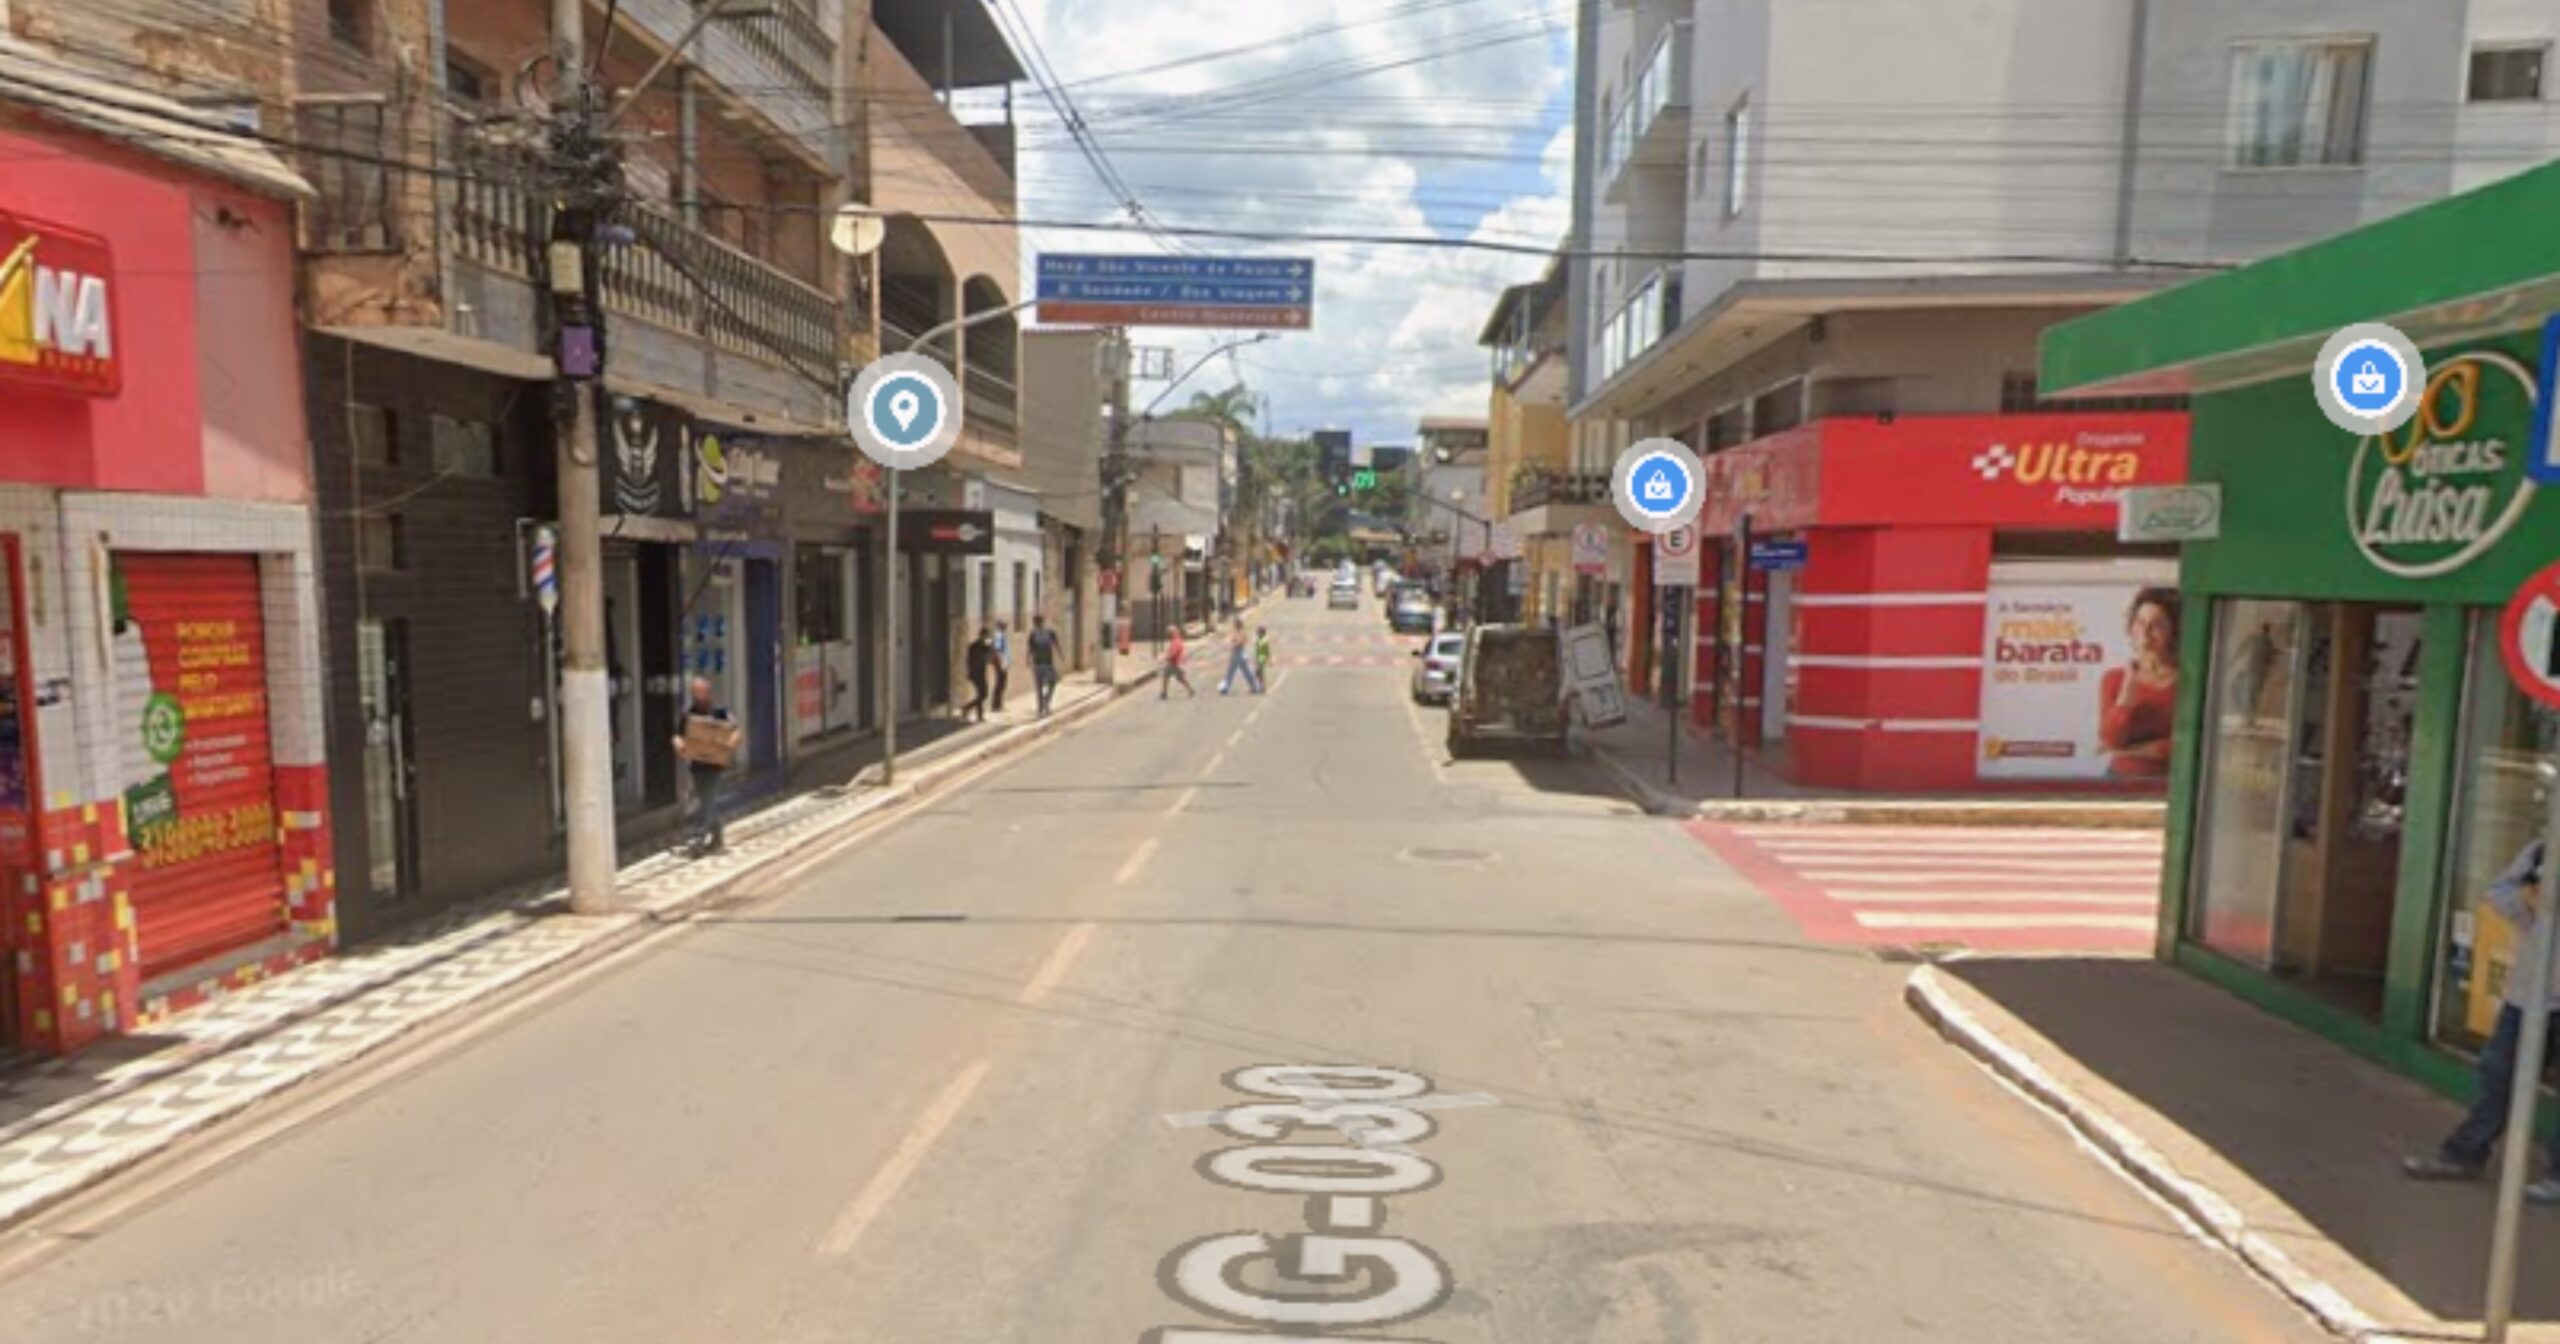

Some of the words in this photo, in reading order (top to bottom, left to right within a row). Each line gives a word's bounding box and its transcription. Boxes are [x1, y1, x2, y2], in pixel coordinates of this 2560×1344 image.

[1133, 262, 1199, 275] Vicente
[1208, 263, 1226, 274] de
[2014, 442, 2139, 484] Ultra
[1669, 530, 1683, 547] E
[1995, 638, 2104, 663] barata
